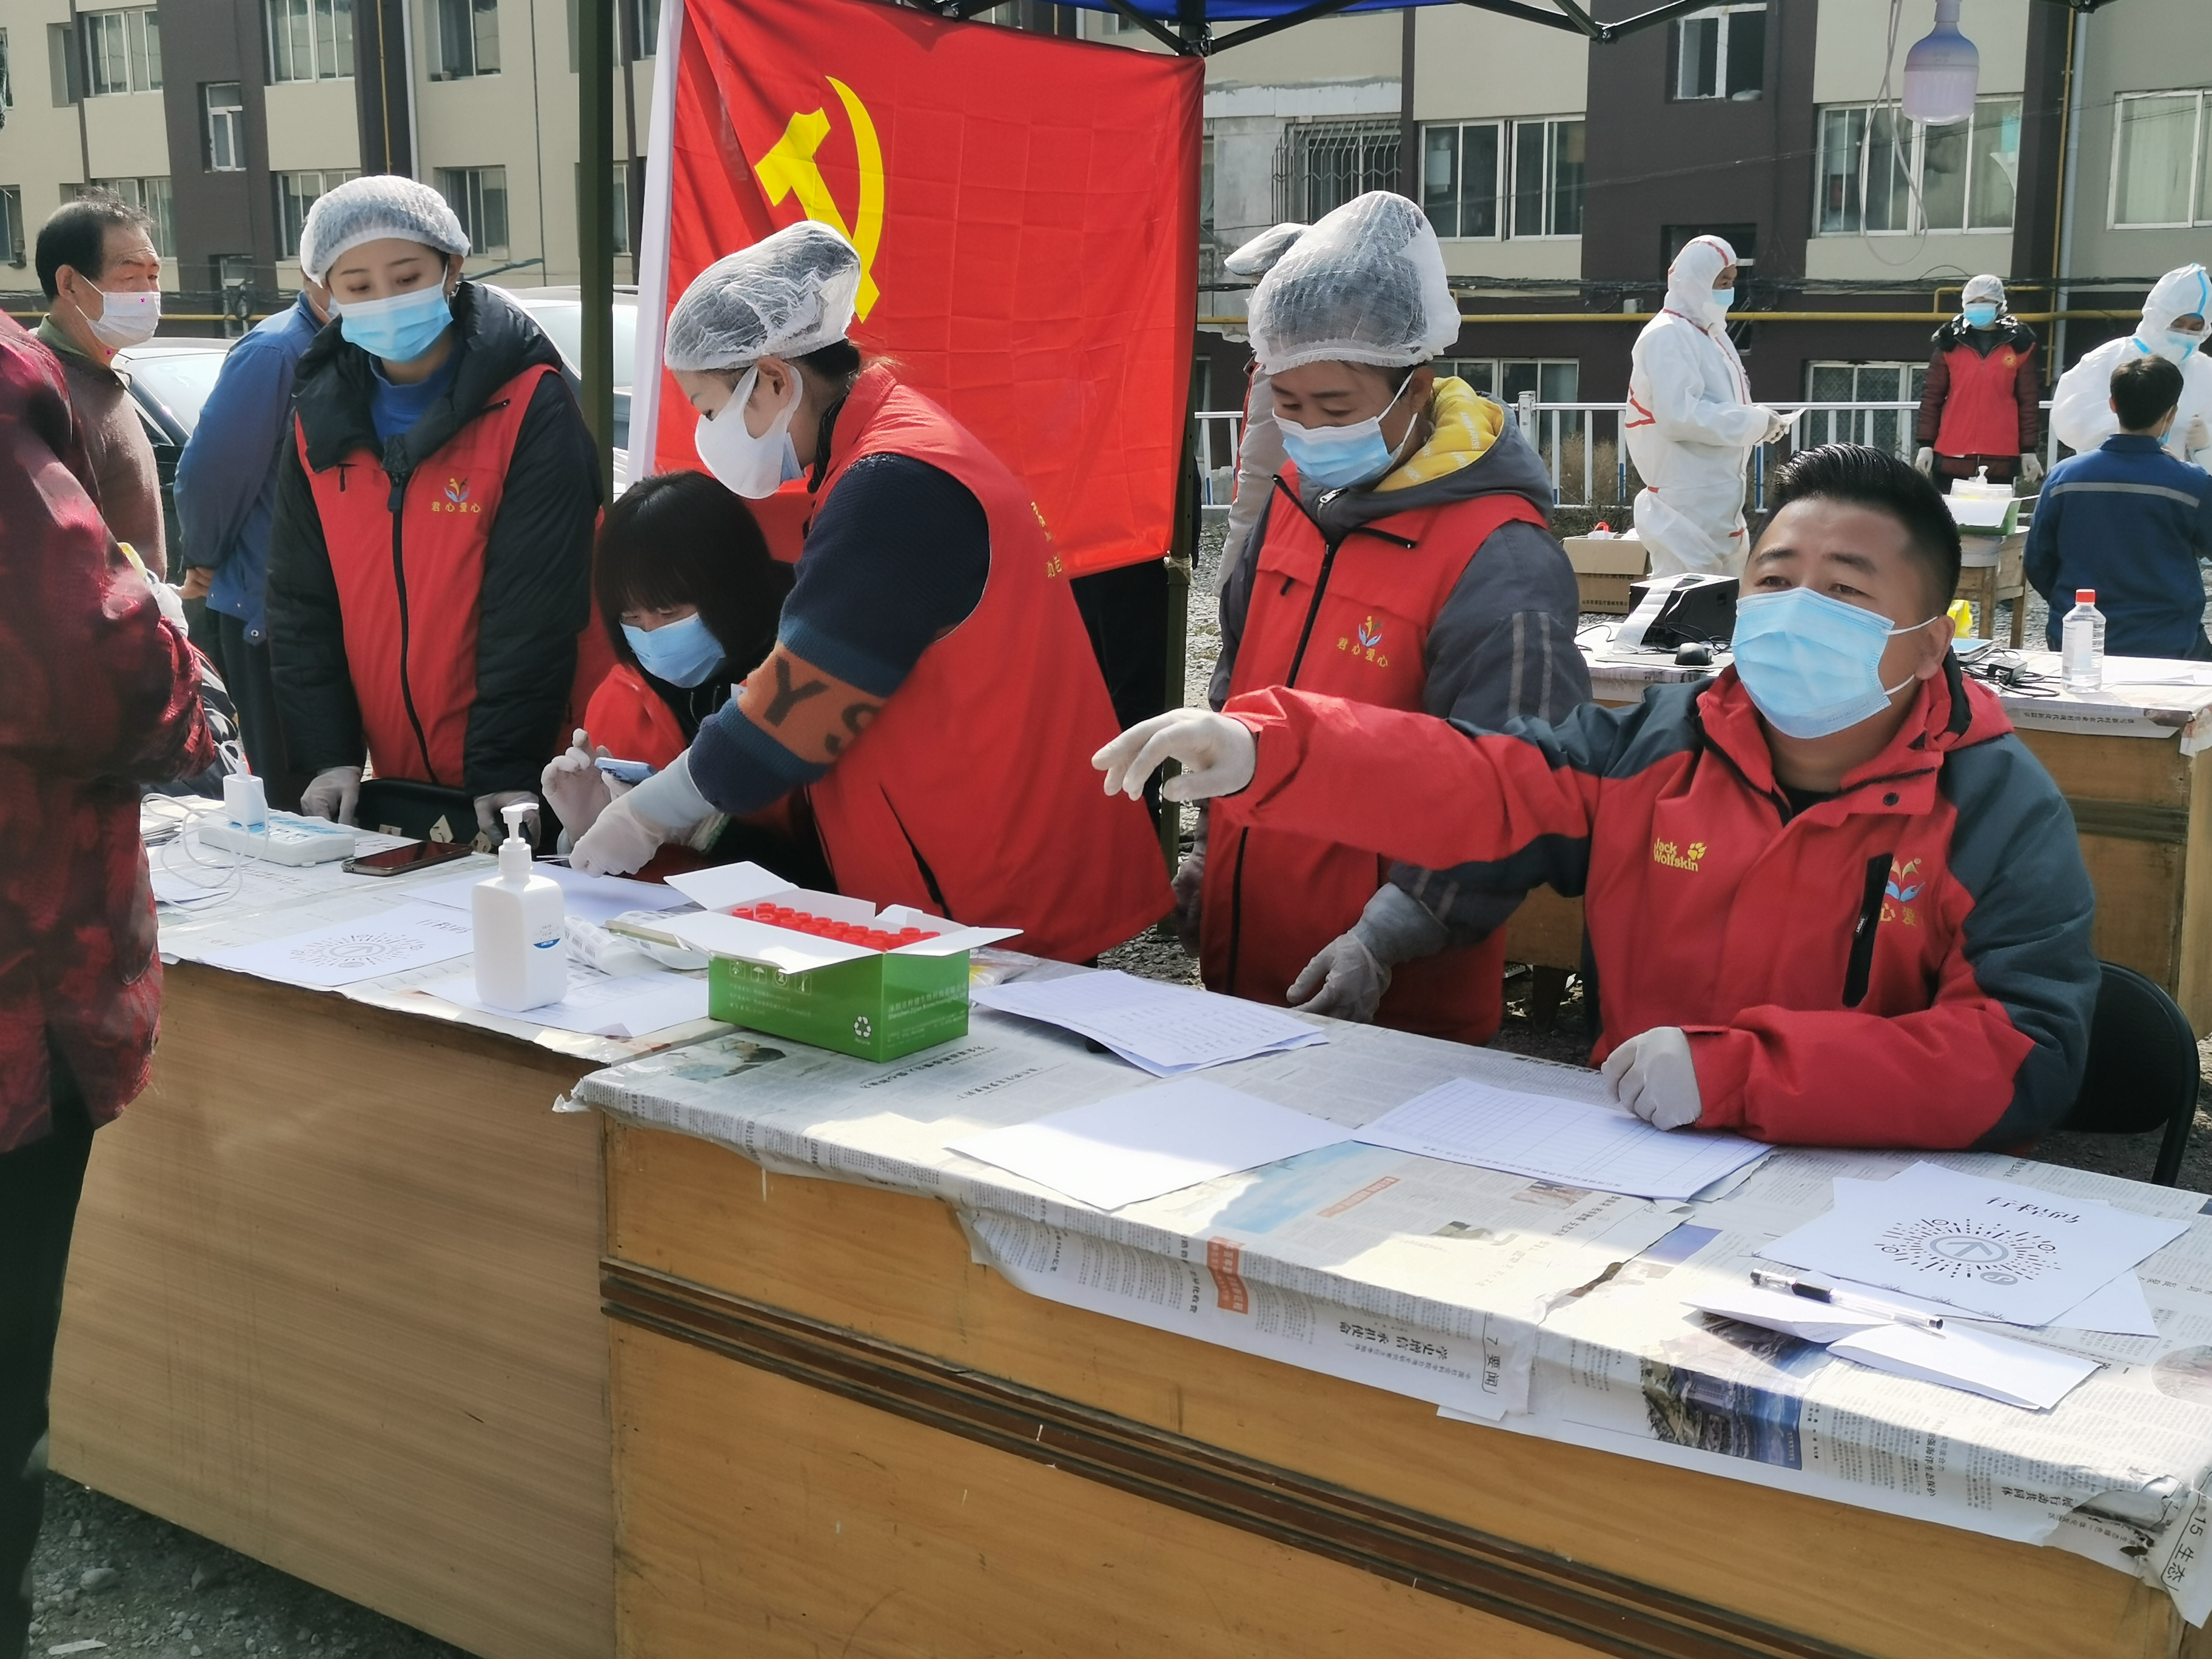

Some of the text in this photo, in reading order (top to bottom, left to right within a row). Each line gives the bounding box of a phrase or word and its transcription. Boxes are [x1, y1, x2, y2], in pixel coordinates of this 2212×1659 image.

[1654, 837, 1677, 855] Jack
[1654, 850, 1698, 872] Wolfskin
[1986, 1196, 2080, 1223] 行程码
[1339, 1321, 1448, 1359] 学史增信 承担使命
[1484, 1336, 1501, 1387] 7 要闻
[2167, 1517, 2207, 1583] 15 生态
